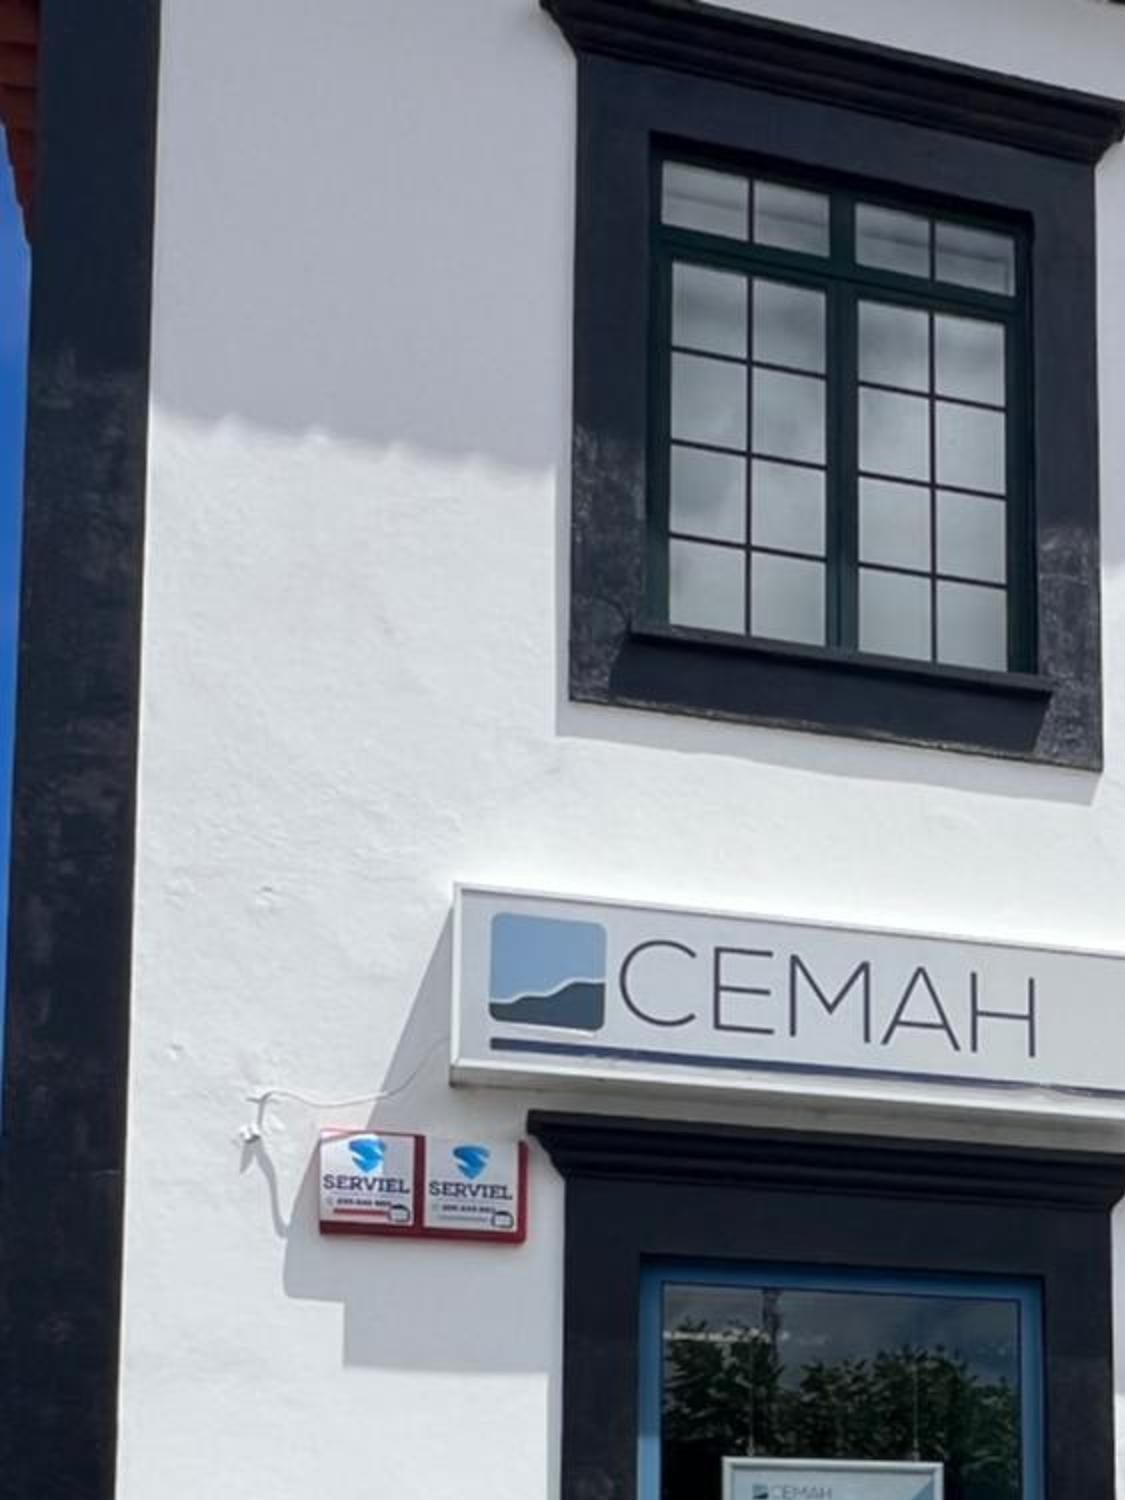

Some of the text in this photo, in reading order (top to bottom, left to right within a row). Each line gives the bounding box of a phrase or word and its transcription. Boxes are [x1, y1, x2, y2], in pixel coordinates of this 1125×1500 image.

[619, 939, 1037, 1058] CEMAH
[322, 1173, 410, 1194] SERVIEL
[428, 1180, 513, 1200] SERVIEL
[770, 1484, 832, 1500] CEMAH
